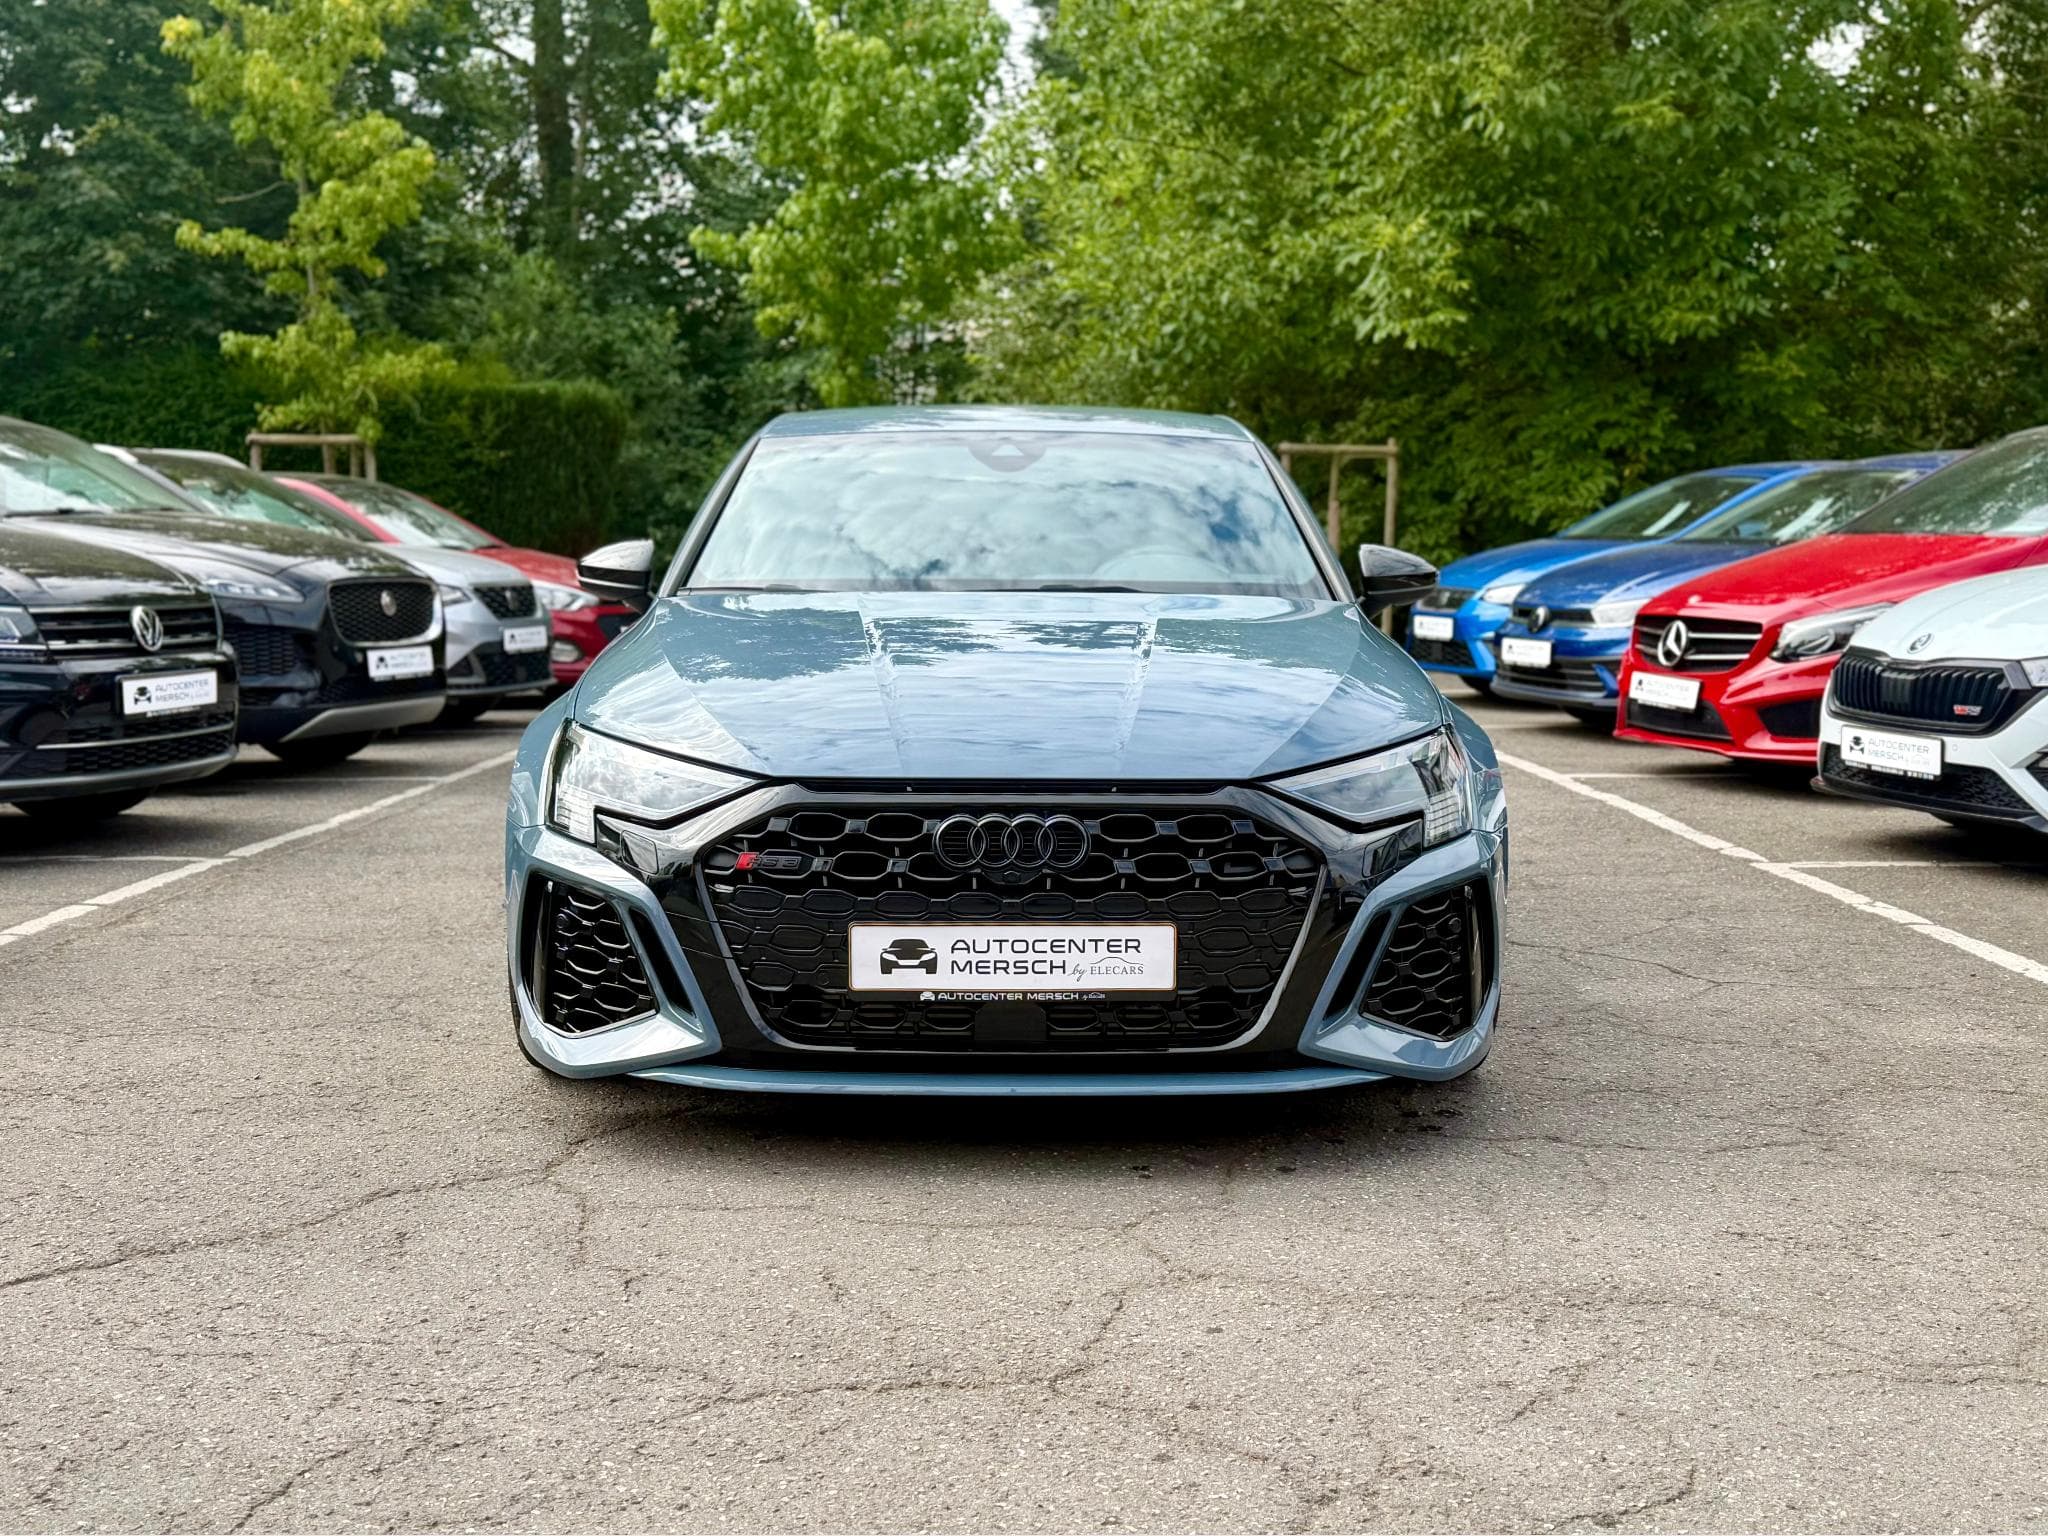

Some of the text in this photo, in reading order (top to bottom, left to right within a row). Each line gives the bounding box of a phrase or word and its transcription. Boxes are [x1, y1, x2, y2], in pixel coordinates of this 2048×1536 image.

[155, 678, 210, 692] AUTOCENTER
[1868, 737, 1930, 754] AUTOCENTER
[1868, 748, 1904, 761] MERSCH
[950, 938, 1142, 954] AUTOCENTER
[950, 959, 1144, 982] MERSCH by ELECARS
[937, 992, 1023, 1001] AUTOCENTER
[1027, 992, 1079, 1001] MERSCH
